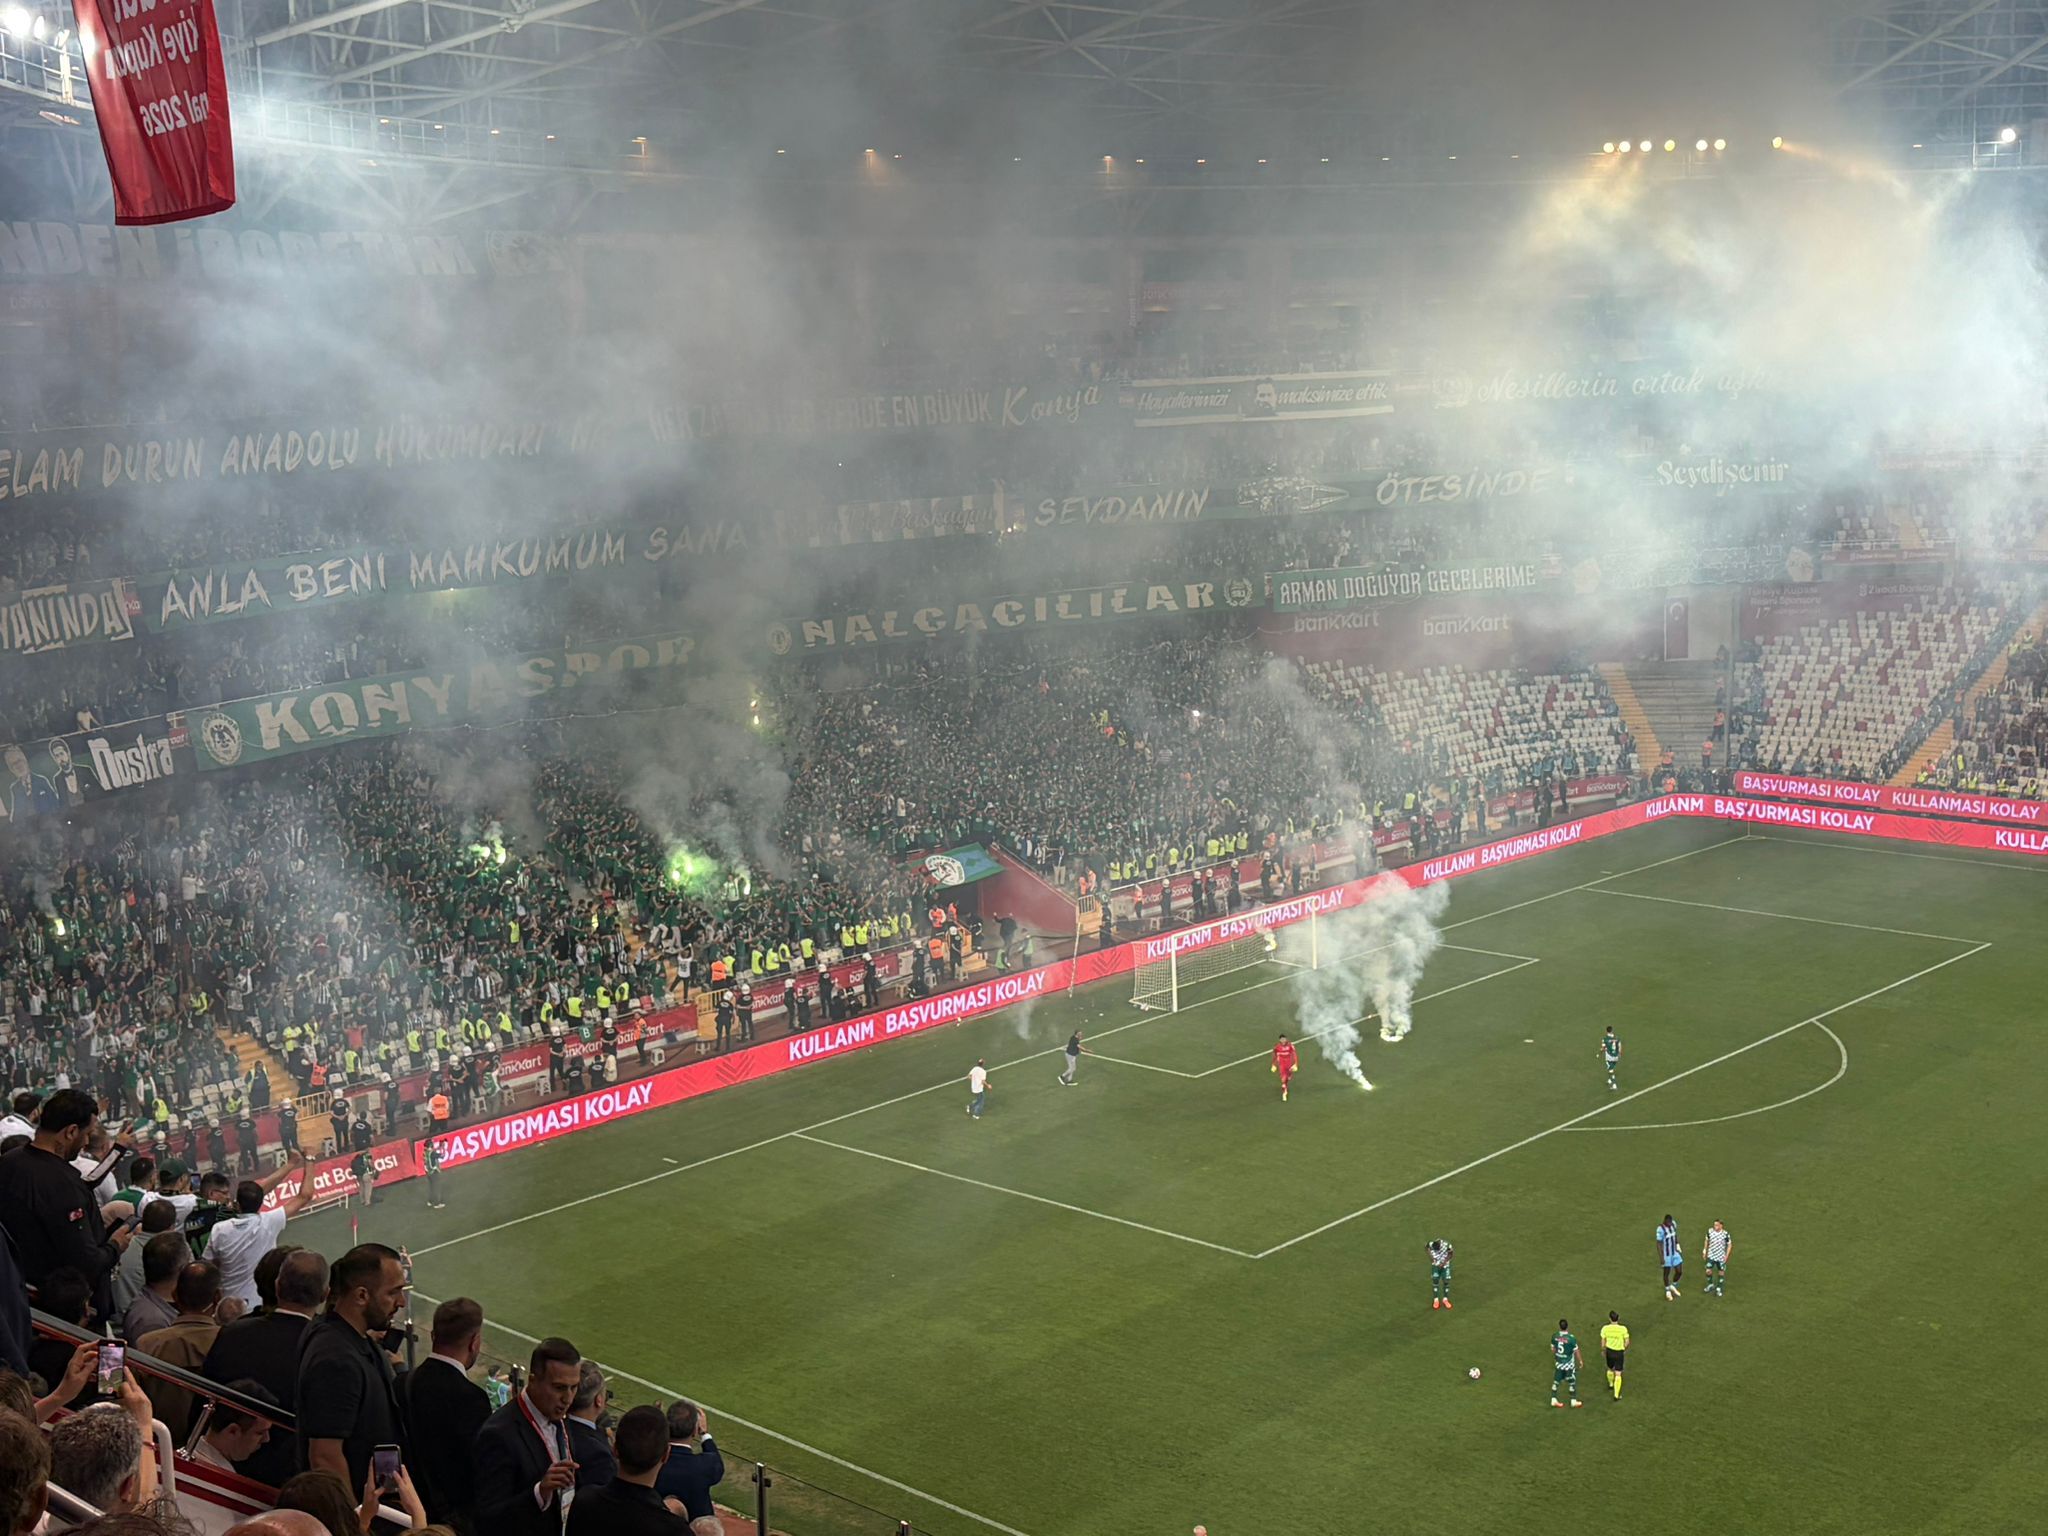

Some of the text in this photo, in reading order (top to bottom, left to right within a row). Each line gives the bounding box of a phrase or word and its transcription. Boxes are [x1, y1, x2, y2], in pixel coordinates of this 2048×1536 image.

[1477, 367, 1619, 402] Nesillerin
[1631, 366, 1705, 396] ortak
[923, 387, 993, 426] BÜYÜK
[1001, 383, 1099, 428] Konya
[102, 438, 206, 489] DURUN
[220, 428, 360, 477] ANADOLU
[1035, 488, 1209, 527] SEVDANIN
[1375, 465, 1552, 506] ÖTESİNDE
[160, 567, 273, 628] ANLA
[408, 529, 627, 590] MAHKUMUM
[642, 523, 748, 562] SANA
[1280, 564, 1537, 606] ARMAN DOĞUYOR GECELERİME
[1423, 613, 1511, 636] bankkart
[1742, 775, 1881, 803] BAŞVURMASI KOLAY
[1891, 792, 2040, 820] KULLANMASI KOLAY
[1645, 797, 1875, 832] KULLANM BAŞVURMASI KOLAY
[1422, 822, 1583, 881] KULLANM BAŞVURMASI KOLAY
[1220, 903, 1303, 939] BAŞVURMASI
[1304, 887, 1345, 915] KOLAY
[788, 970, 1047, 1061] KULLANM BAŞVURMASI KOLAY
[584, 1084, 654, 1121] KOLAY
[332, 1154, 399, 1185] Baası
[1557, 1341, 1565, 1354] 5
